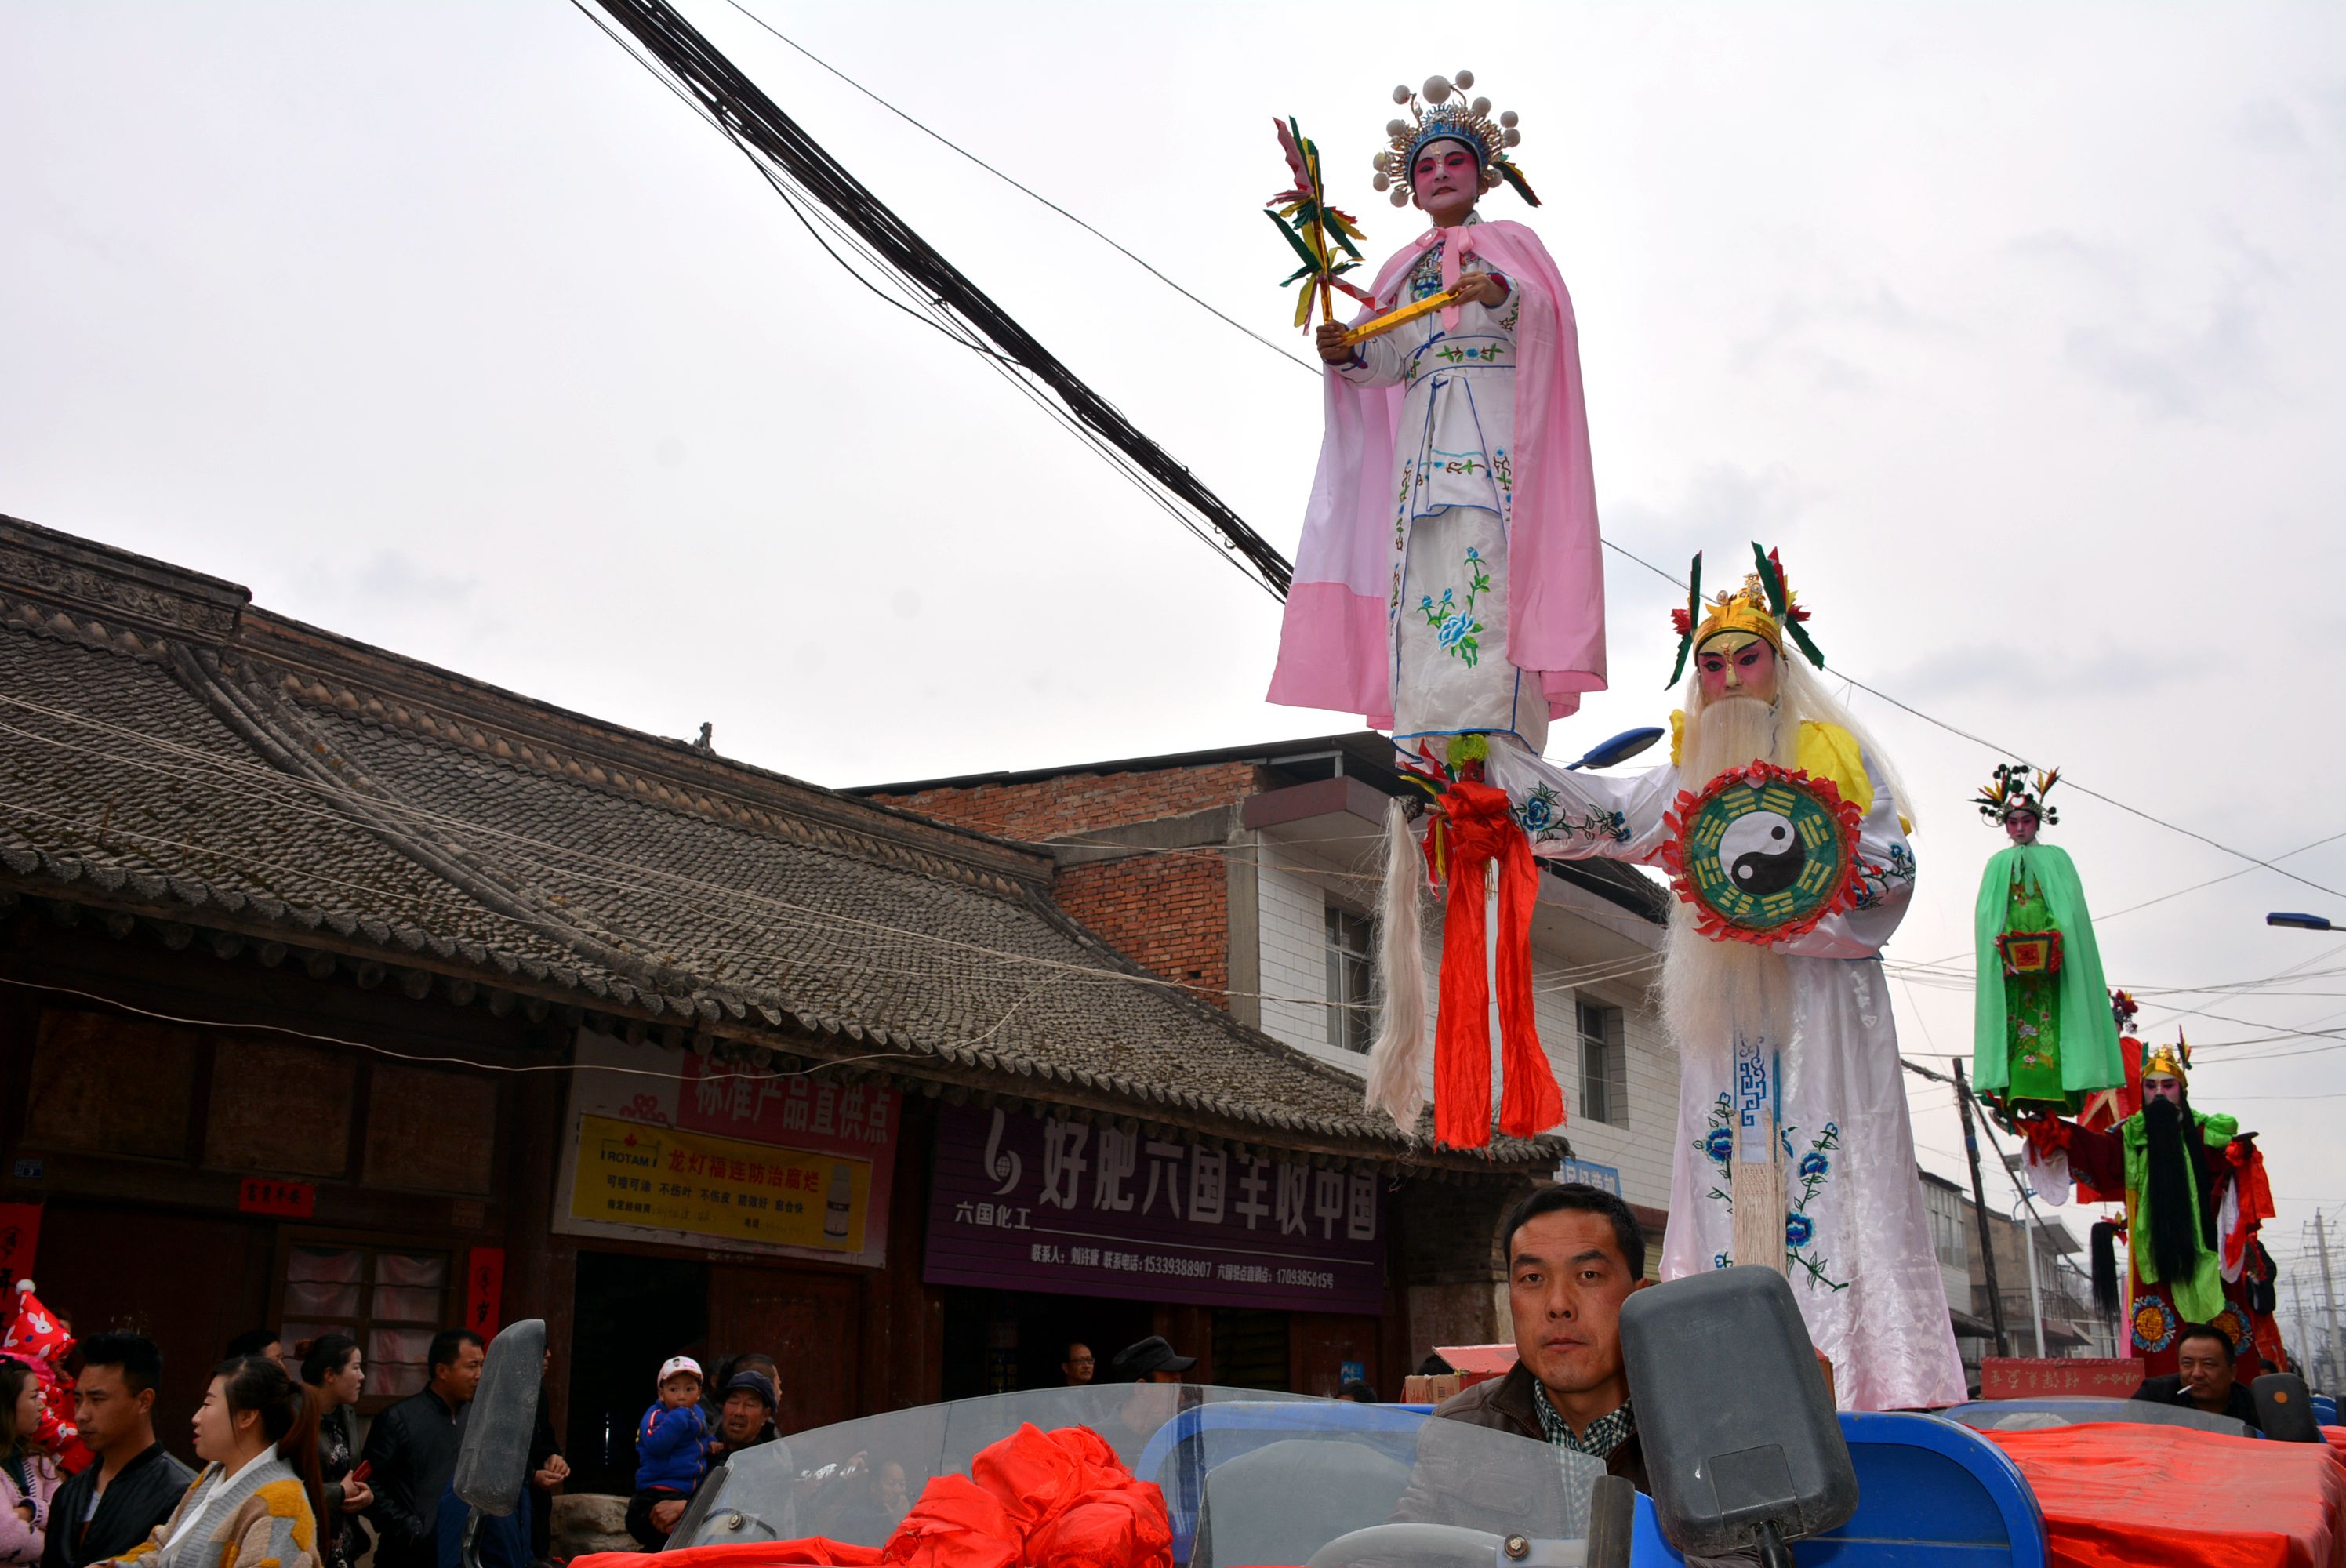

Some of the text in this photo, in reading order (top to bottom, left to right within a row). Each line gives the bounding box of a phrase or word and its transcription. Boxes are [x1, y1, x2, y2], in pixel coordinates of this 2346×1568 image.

[695, 1054, 892, 1144] 标准产品直供点
[608, 1151, 649, 1167] ROTAM
[668, 1149, 819, 1192] 龙灯福连防治腐烂
[659, 1182, 692, 1199] 不伤叶
[700, 1189, 731, 1205] 不伤皮
[954, 1200, 1031, 1230] 六国化工
[2094, 1370, 2141, 1386] 娃哈哈
